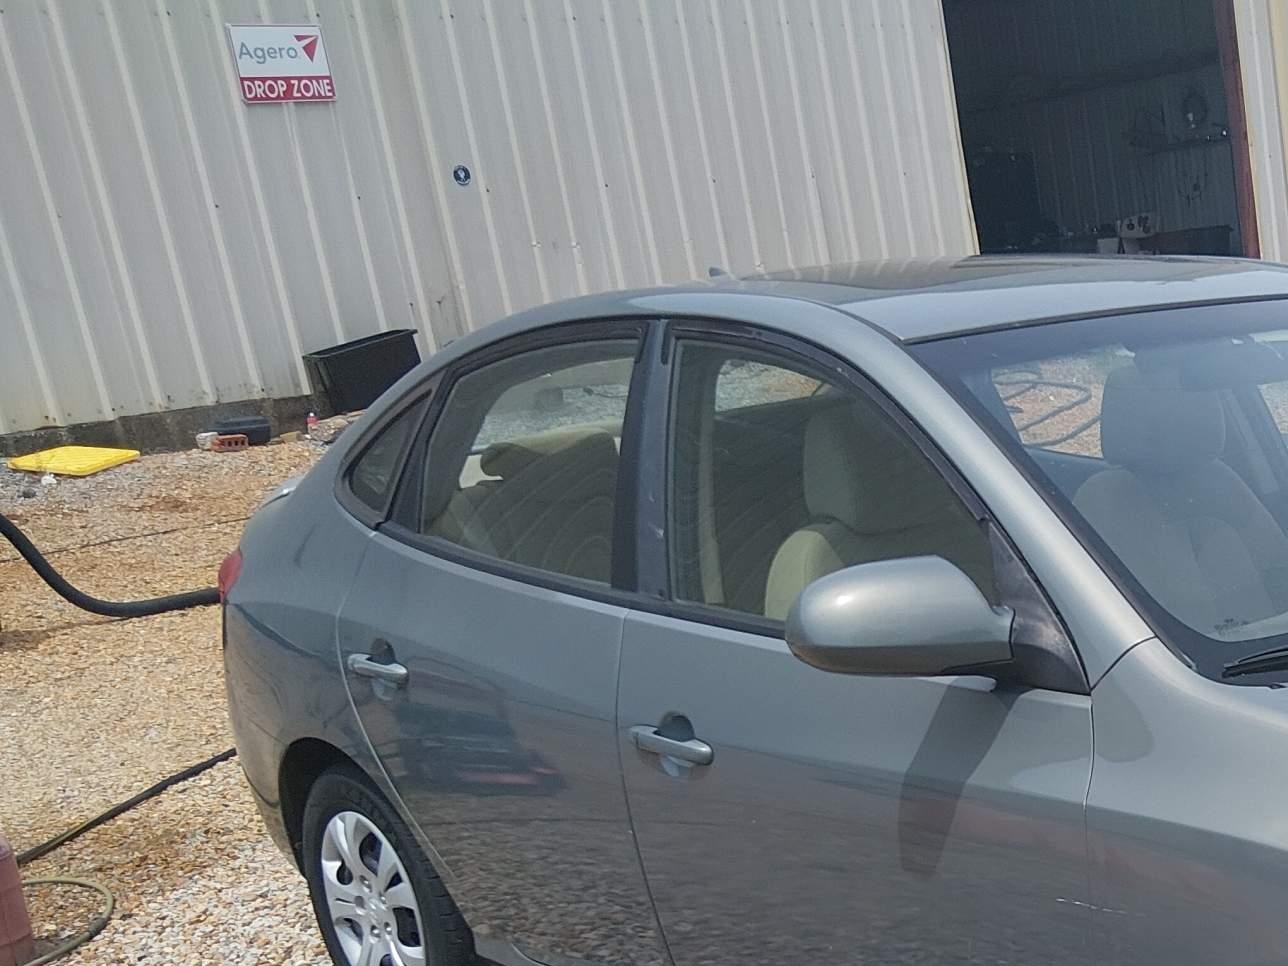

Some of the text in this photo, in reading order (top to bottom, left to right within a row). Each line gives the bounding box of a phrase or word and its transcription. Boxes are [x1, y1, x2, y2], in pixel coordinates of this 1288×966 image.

[239, 42, 298, 64] Agero
[244, 80, 333, 98] DROP ZONE
